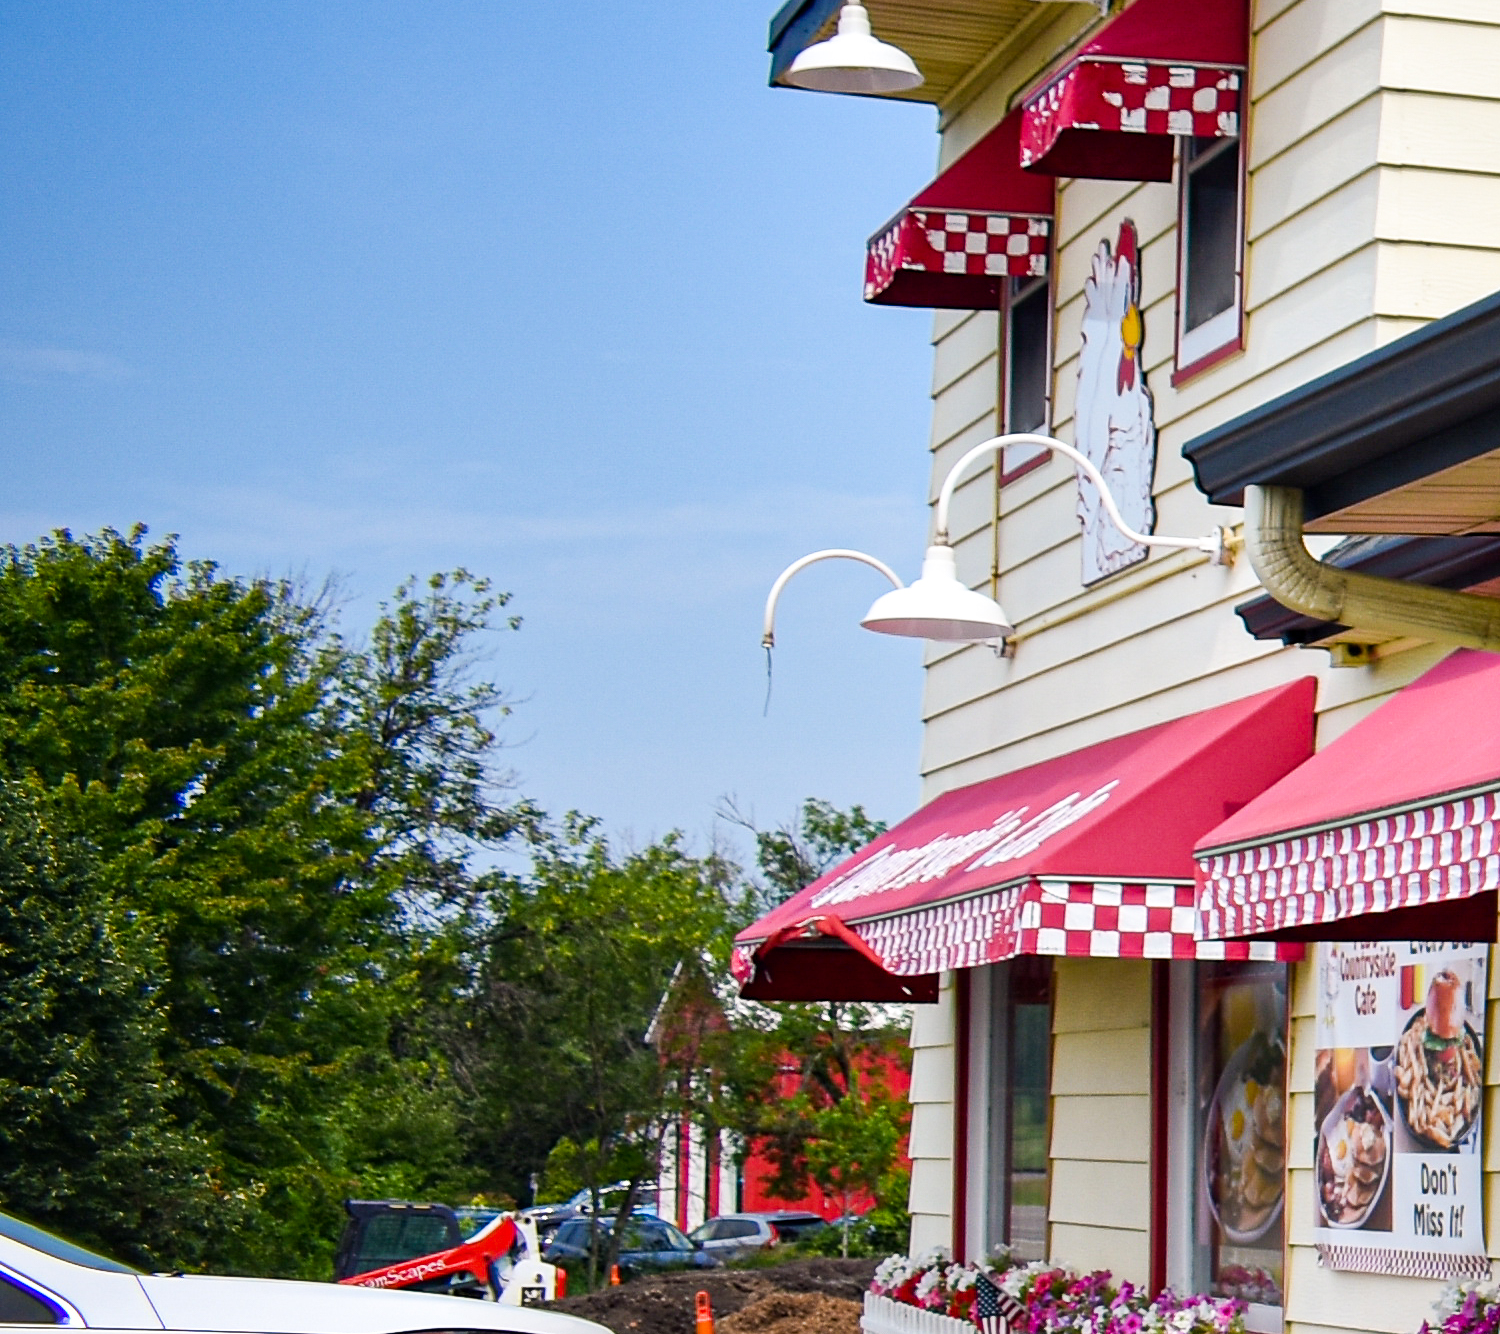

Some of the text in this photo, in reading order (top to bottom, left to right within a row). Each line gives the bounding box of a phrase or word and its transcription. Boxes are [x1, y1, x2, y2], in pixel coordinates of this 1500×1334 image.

[1354, 982, 1377, 1015] Cafe
[1421, 1163, 1457, 1195] Don't
[1413, 1204, 1465, 1237] Miss It!
